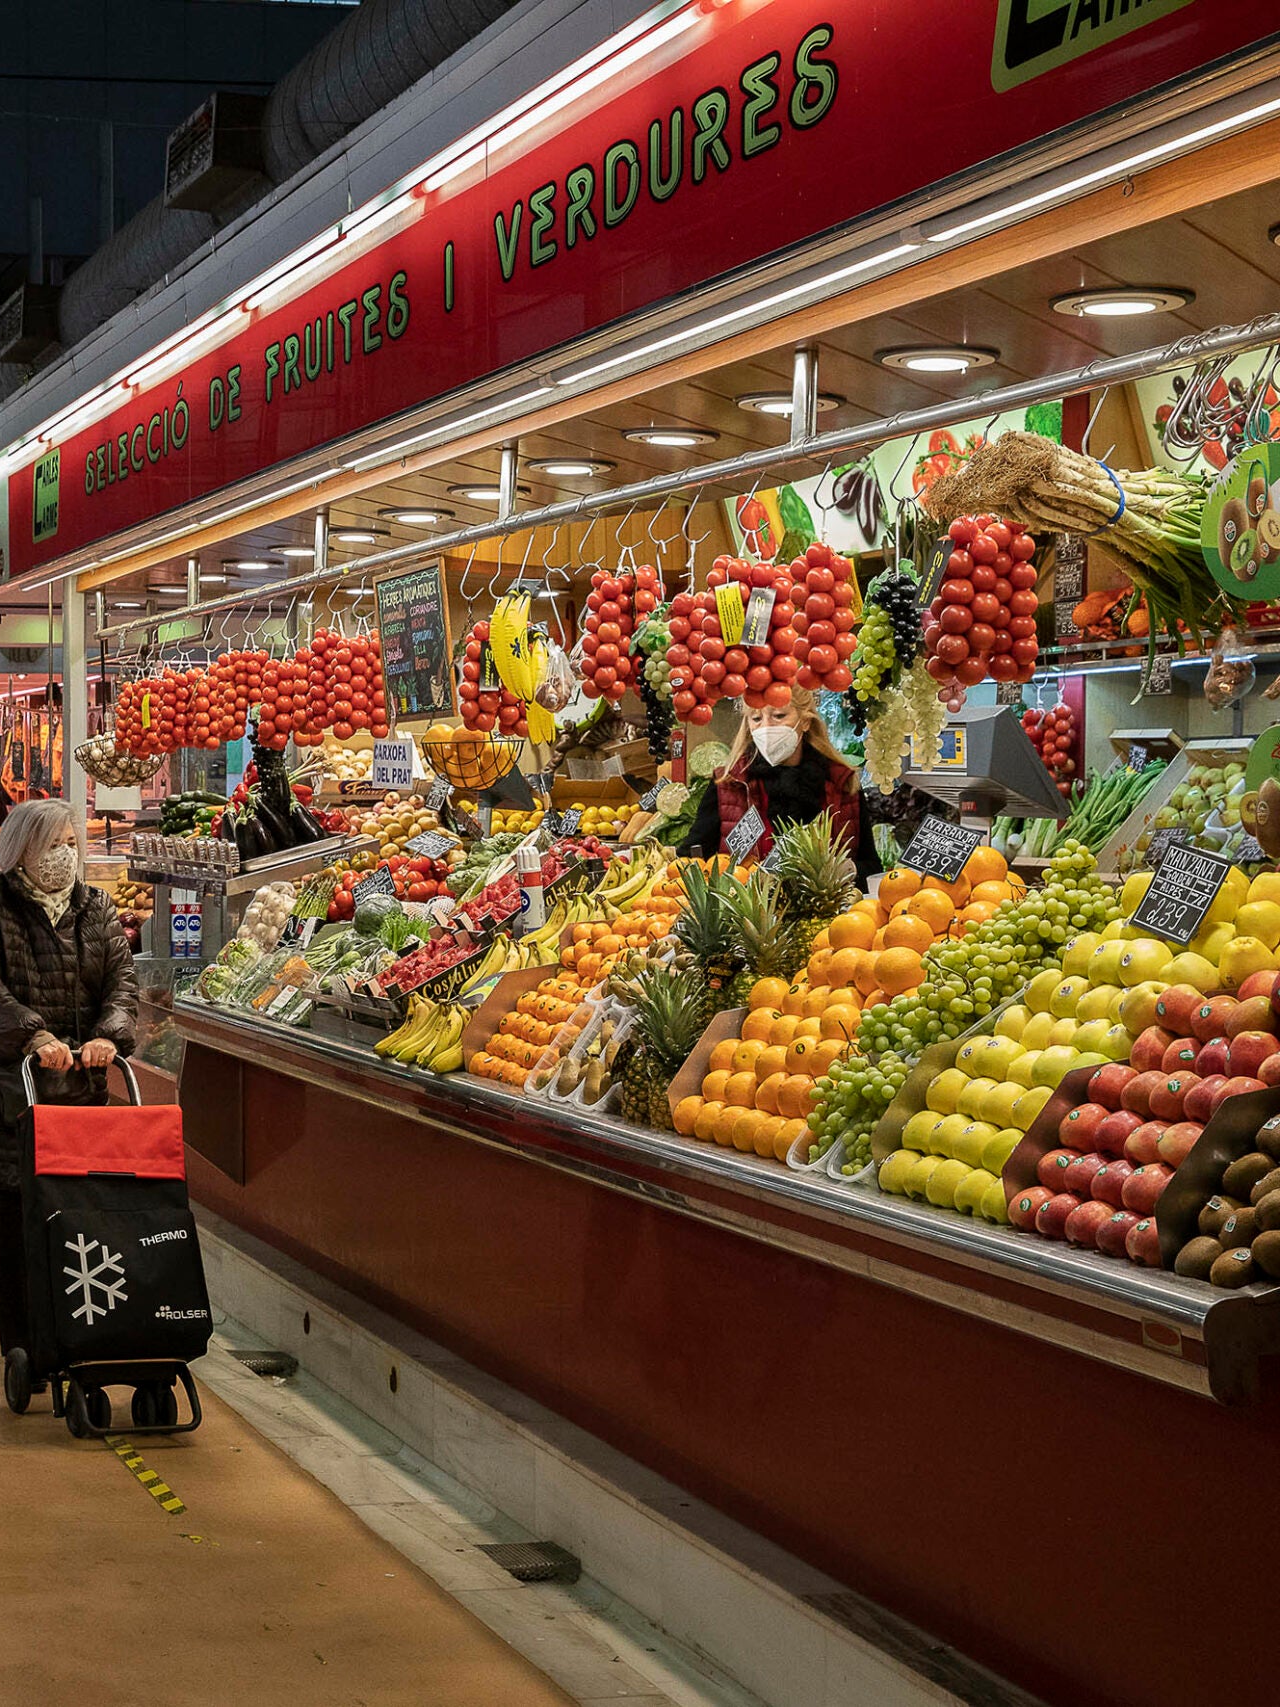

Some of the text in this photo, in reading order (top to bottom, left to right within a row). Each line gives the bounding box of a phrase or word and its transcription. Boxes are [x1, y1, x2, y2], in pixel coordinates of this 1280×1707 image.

[84, 22, 840, 496] SELECCIÓ DE FRUITES I VERDURES
[382, 589, 402, 610] HERBES
[410, 600, 438, 617] CORIANDRE
[374, 744, 407, 762] CARXOFA
[377, 767, 412, 785] DEL PRAT
[925, 819, 977, 845] NARANJA
[911, 847, 952, 874] 2'39
[1165, 848, 1217, 880] MANZANA
[1165, 869, 1194, 887] GOLDEN
[1159, 881, 1183, 900] ALPES
[1146, 897, 1188, 930] 2'39
[139, 1229, 188, 1247] THERMO
[166, 1309, 208, 1320] ROLSER
